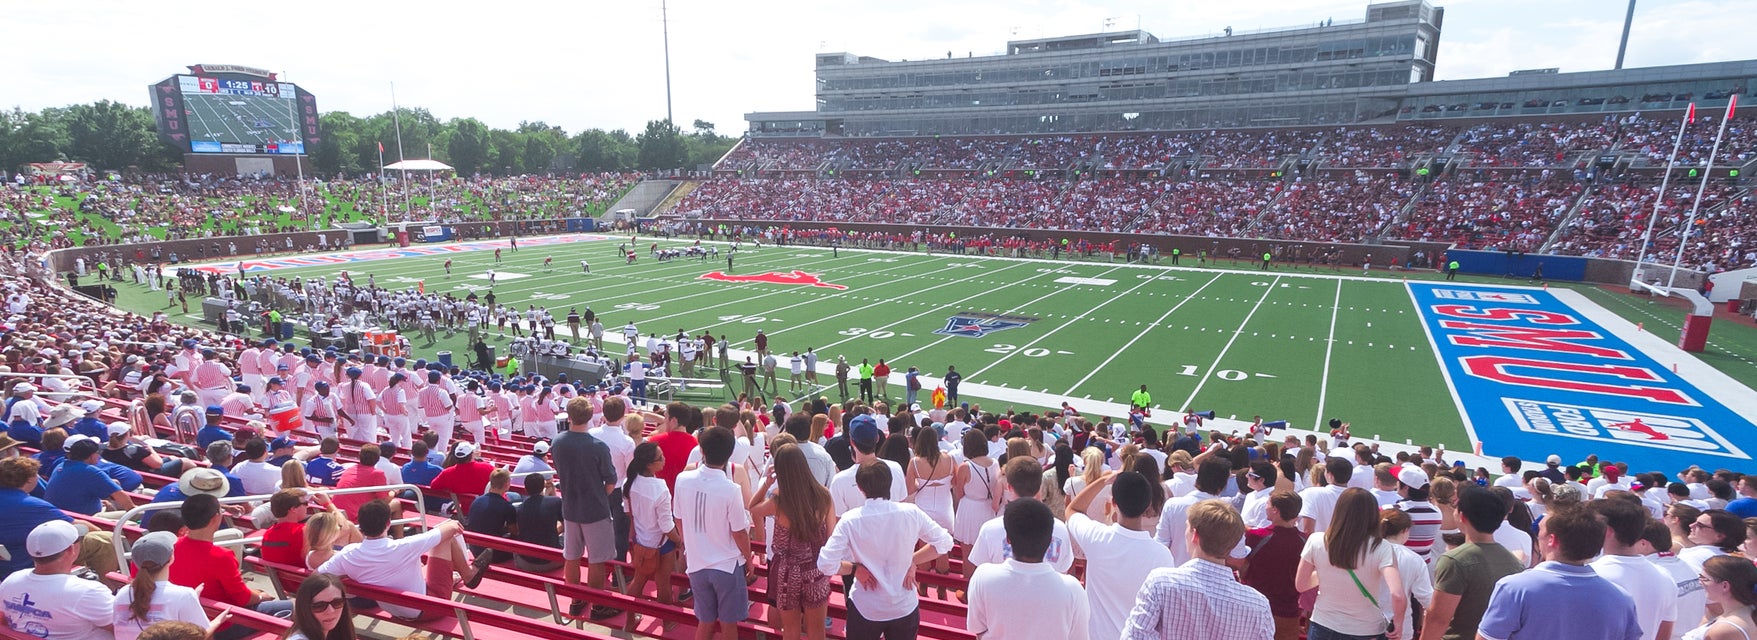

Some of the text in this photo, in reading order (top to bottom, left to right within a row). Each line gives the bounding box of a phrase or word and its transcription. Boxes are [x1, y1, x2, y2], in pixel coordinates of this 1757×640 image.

[226, 81, 248, 89] 1:25
[164, 97, 178, 130] SMU
[305, 105, 316, 134] SMU
[838, 327, 896, 340] 30
[983, 343, 1051, 358] 20
[1431, 303, 1704, 408] SMU
[1176, 364, 1249, 381] 10
[1545, 405, 1601, 437] FORD
